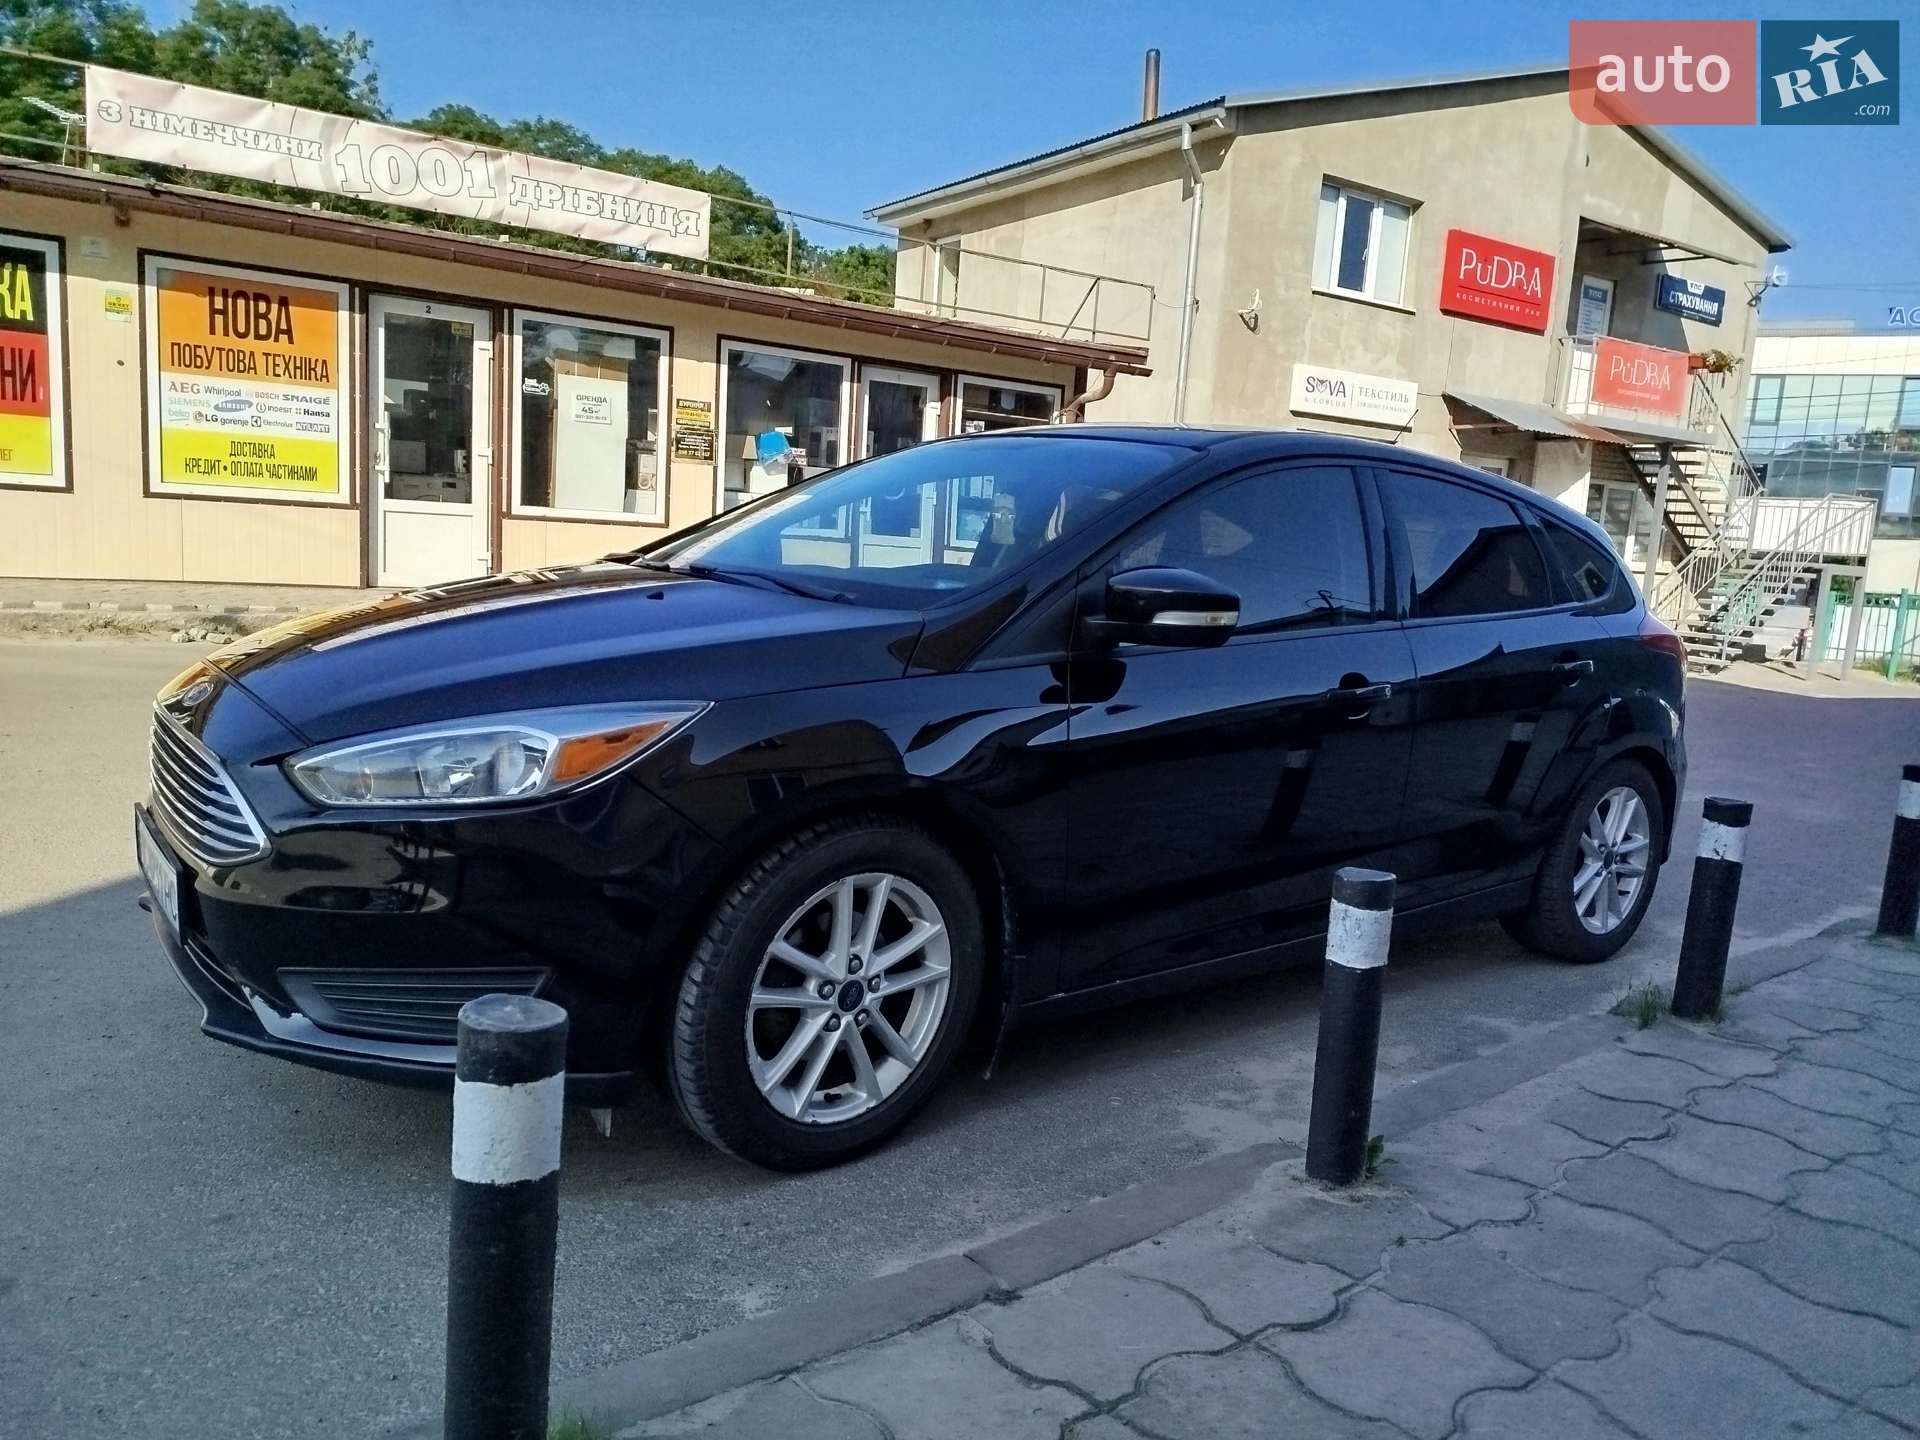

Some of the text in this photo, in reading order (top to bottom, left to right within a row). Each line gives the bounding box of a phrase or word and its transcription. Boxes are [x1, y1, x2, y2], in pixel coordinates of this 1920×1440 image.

[130, 105, 323, 162] НІМЕЧЧИНИ
[334, 143, 497, 198] 1001
[510, 175, 700, 238] ДРІБНИЦЯ
[425, 304, 432, 314] 2
[1669, 290, 1719, 316] СТРАХУВАННЯ
[208, 286, 295, 345] НОВА
[170, 341, 331, 383] ПОБУТОВА ТЕХНІКА
[168, 381, 201, 395] AEG
[203, 385, 242, 398] Whirlpool
[254, 391, 280, 400] BOSCH
[576, 394, 608, 404] ОРЕНДА
[1358, 386, 1409, 404] ТЕКСТИЛЬ
[168, 396, 211, 408] SIEMENS
[217, 400, 251, 411] SAMSUNG
[303, 409, 331, 418] Hansa
[581, 406, 594, 414] 45
[168, 408, 191, 419] beko
[205, 413, 219, 423] LG
[220, 418, 249, 427] gorenje
[262, 419, 294, 428] Electrolux
[229, 440, 276, 460] ДОСТАВКА
[184, 457, 318, 482] КРЕДИТ ОПЛАТА ЧАСТИНАМИ
